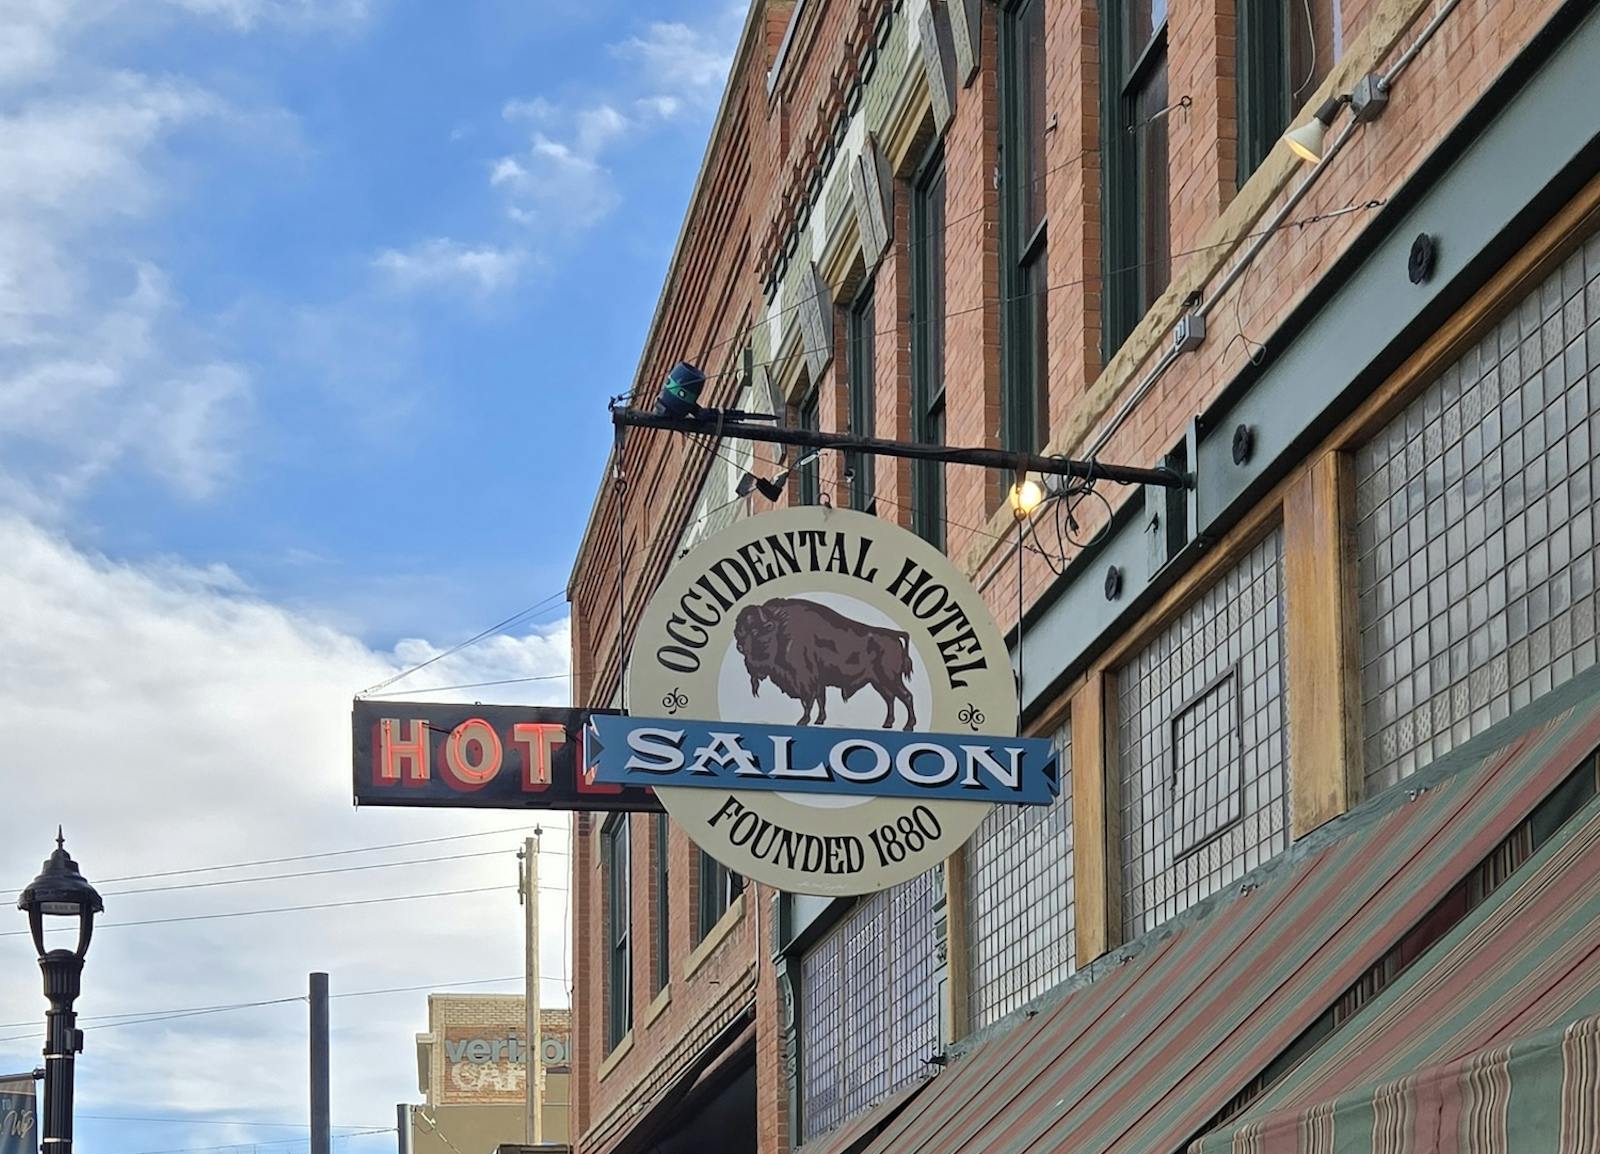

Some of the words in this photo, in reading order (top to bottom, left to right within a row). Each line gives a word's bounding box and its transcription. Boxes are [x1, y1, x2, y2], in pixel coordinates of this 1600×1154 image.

[656, 530, 880, 674] OCCIDENTAL
[886, 557, 988, 689] HOTEL
[372, 717, 625, 794] HOT
[624, 727, 1026, 790] SALOON
[707, 795, 865, 874] FOUNDED
[869, 805, 942, 867] 1880
[452, 1061, 546, 1091] CAF
